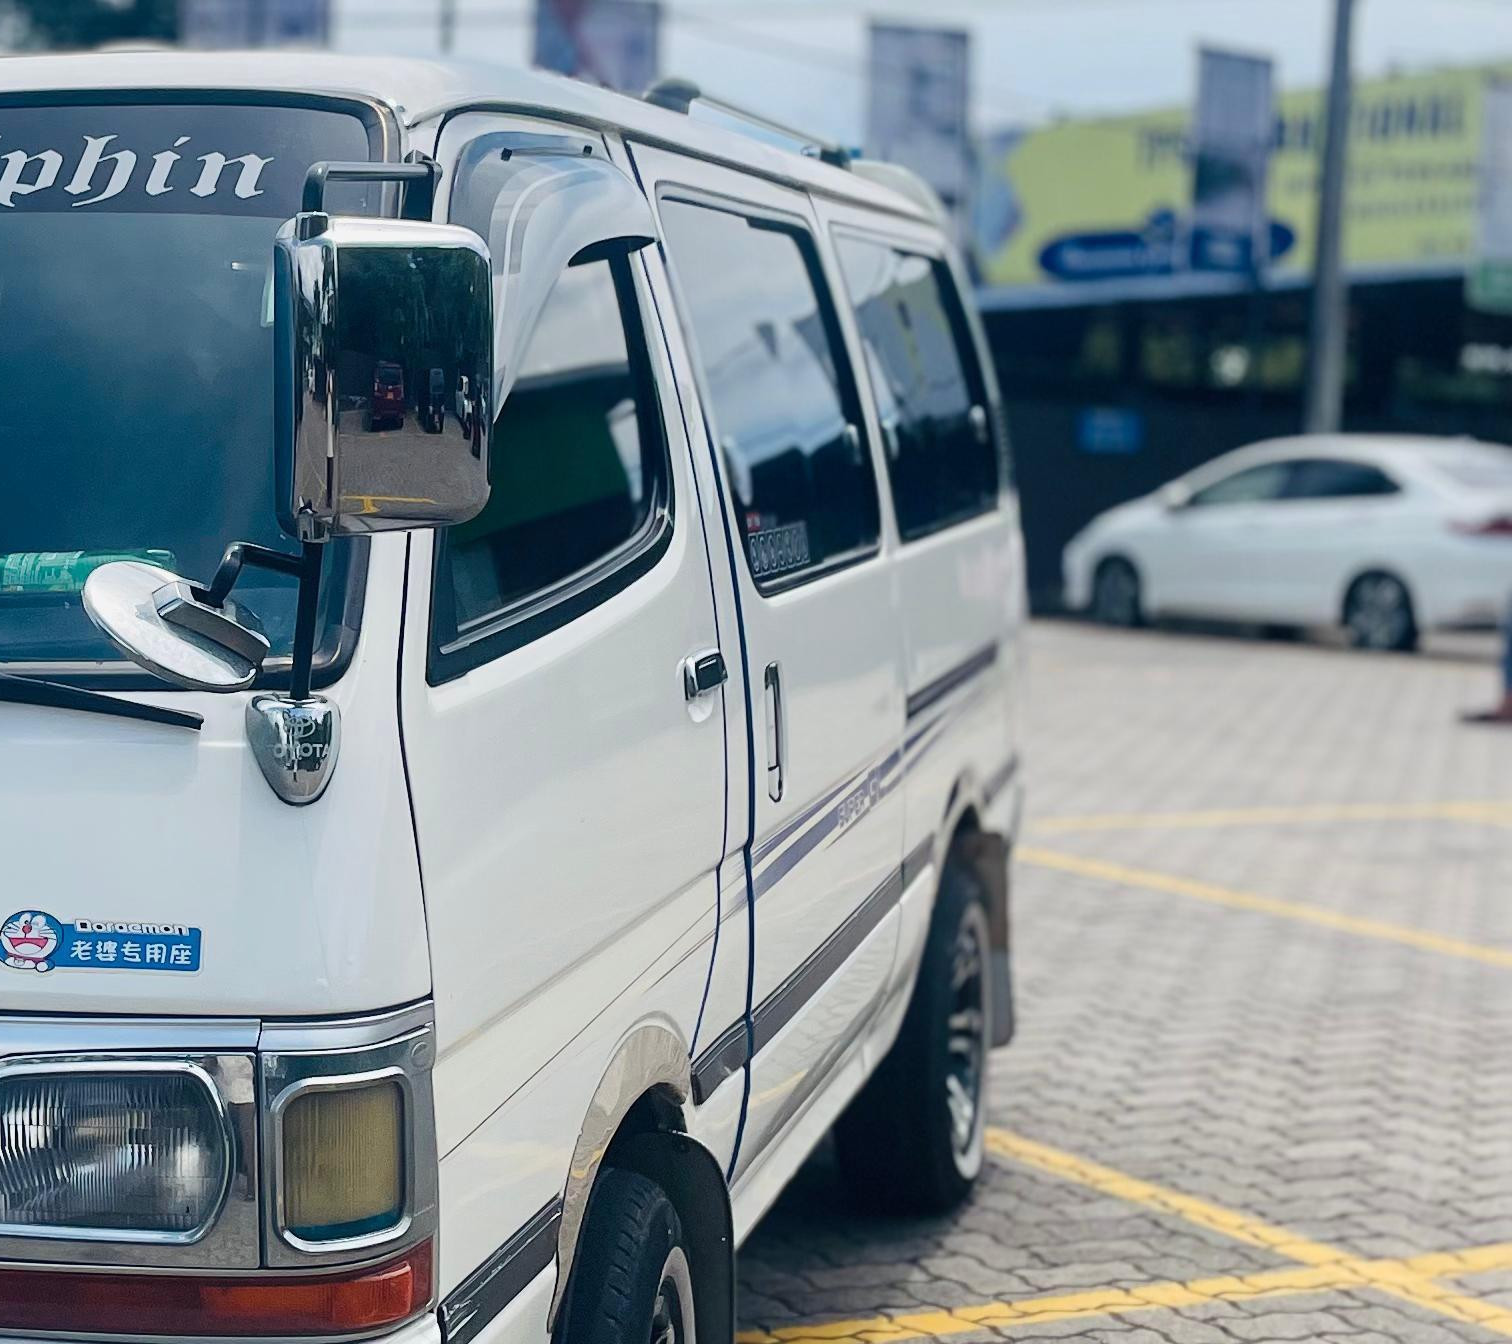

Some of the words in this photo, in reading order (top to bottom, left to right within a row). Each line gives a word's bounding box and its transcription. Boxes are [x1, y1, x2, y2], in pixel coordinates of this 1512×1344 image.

[74, 919, 190, 937] Doraemon
[70, 940, 192, 966] 老婆专用座
